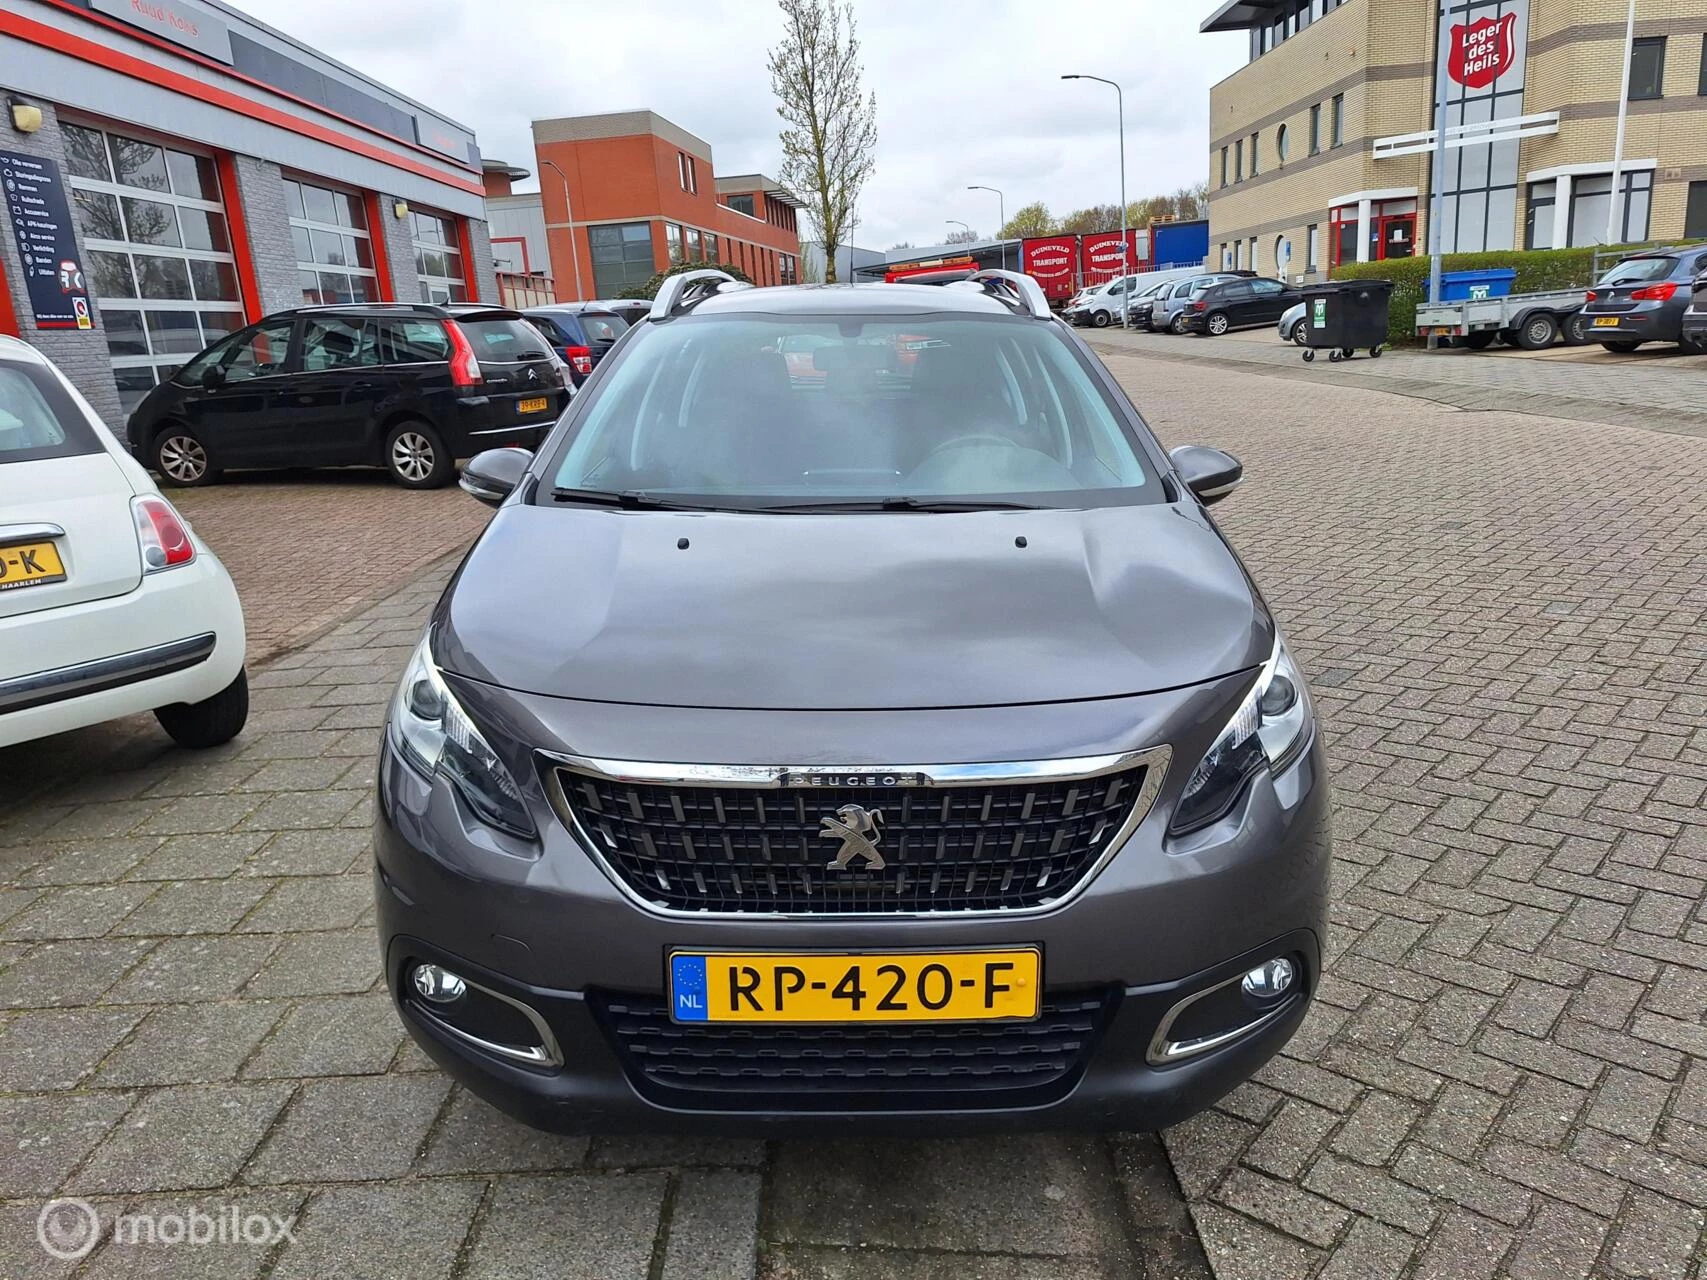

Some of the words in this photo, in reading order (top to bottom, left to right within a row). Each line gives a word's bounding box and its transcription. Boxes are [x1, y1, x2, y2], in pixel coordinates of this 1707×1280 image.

[1462, 22, 1503, 48] Leger
[1468, 41, 1494, 60] des
[1463, 54, 1500, 76] Heils
[1031, 245, 1070, 257] DUINEVELD
[1091, 252, 1126, 262] TRANSPOR
[1033, 257, 1068, 267] TRANSPORT
[1, 579, 42, 590] HAARLEM
[794, 775, 913, 787] PEUGEOT
[679, 994, 702, 1009] NL
[728, 962, 1014, 1012] RP-420-F
